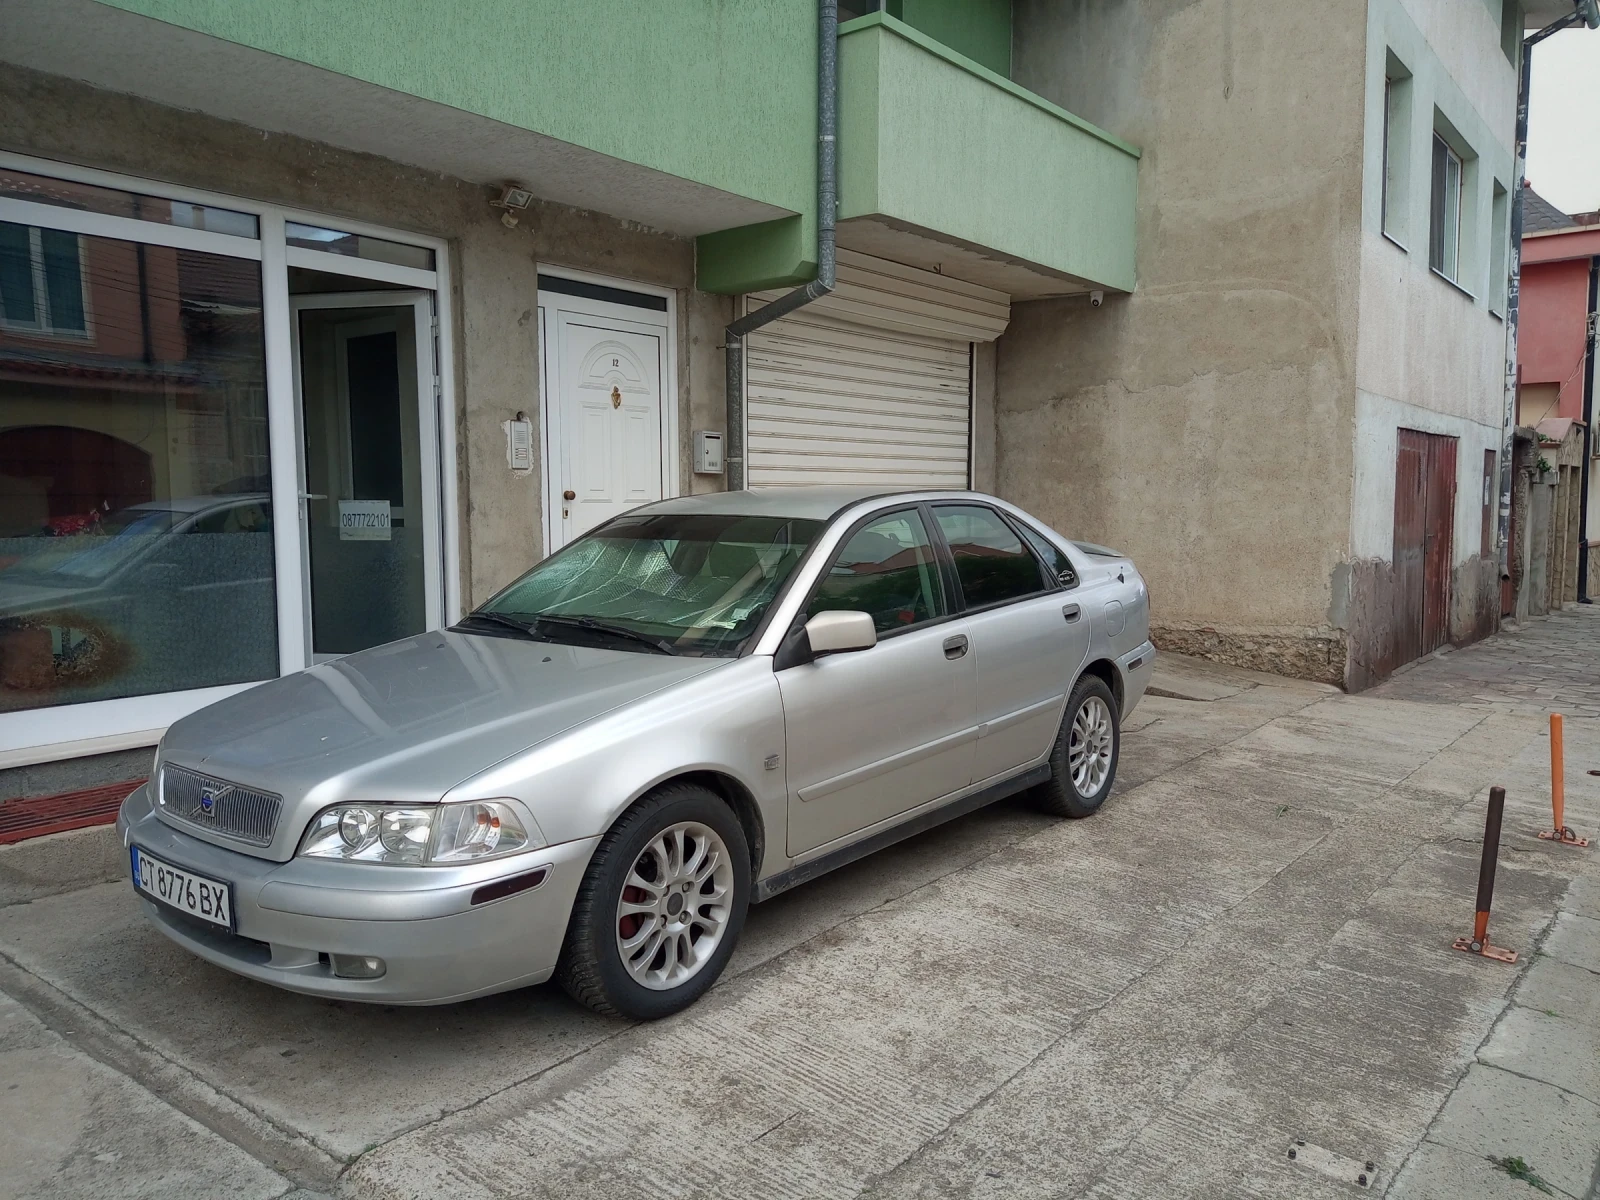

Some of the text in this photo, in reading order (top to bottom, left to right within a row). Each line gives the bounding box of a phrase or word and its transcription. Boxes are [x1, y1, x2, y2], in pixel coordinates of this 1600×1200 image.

[612, 358, 619, 367] 12
[342, 513, 390, 527] 0877722101
[140, 857, 226, 921] CT 8776 BX
